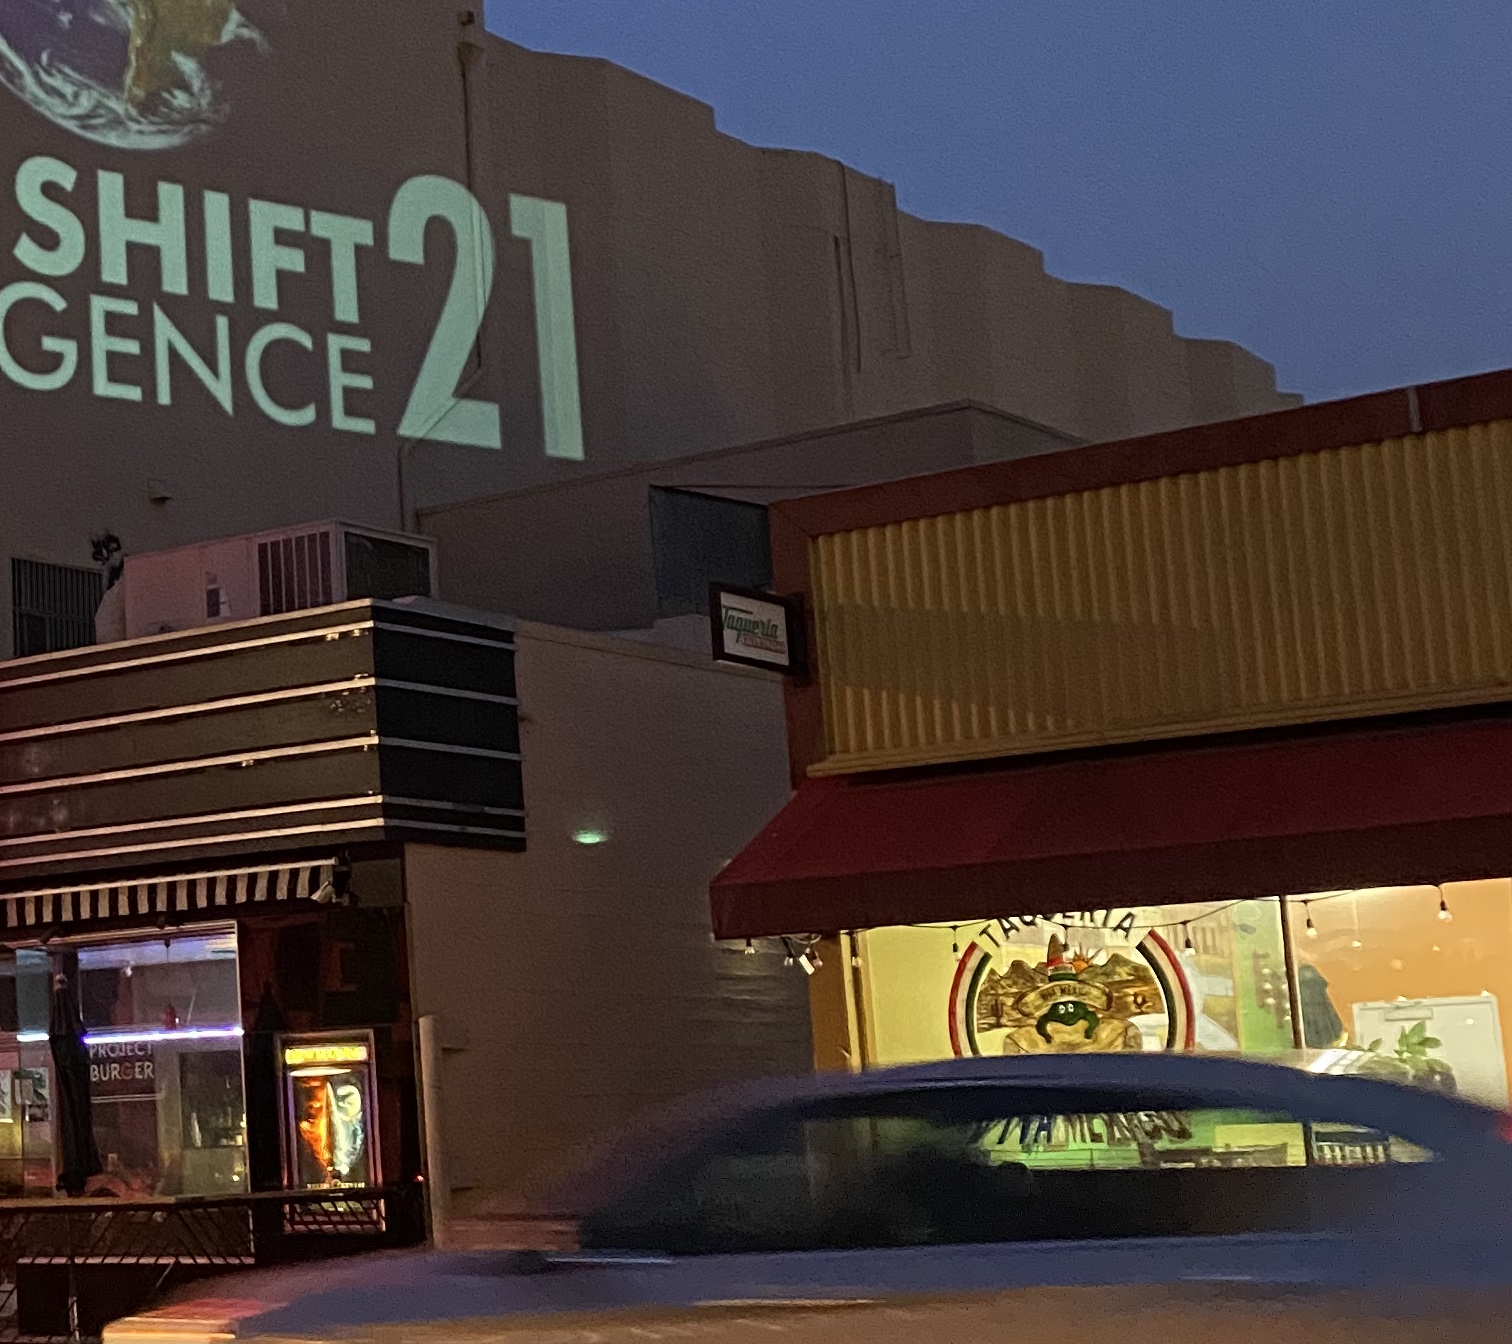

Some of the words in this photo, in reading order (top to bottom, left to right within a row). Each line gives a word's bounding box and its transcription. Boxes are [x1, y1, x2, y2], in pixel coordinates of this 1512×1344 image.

[12, 156, 374, 324] SHIFT
[388, 174, 584, 460] 21
[89, 1041, 153, 1058] PROJECT
[90, 1061, 154, 1082] BURGER
